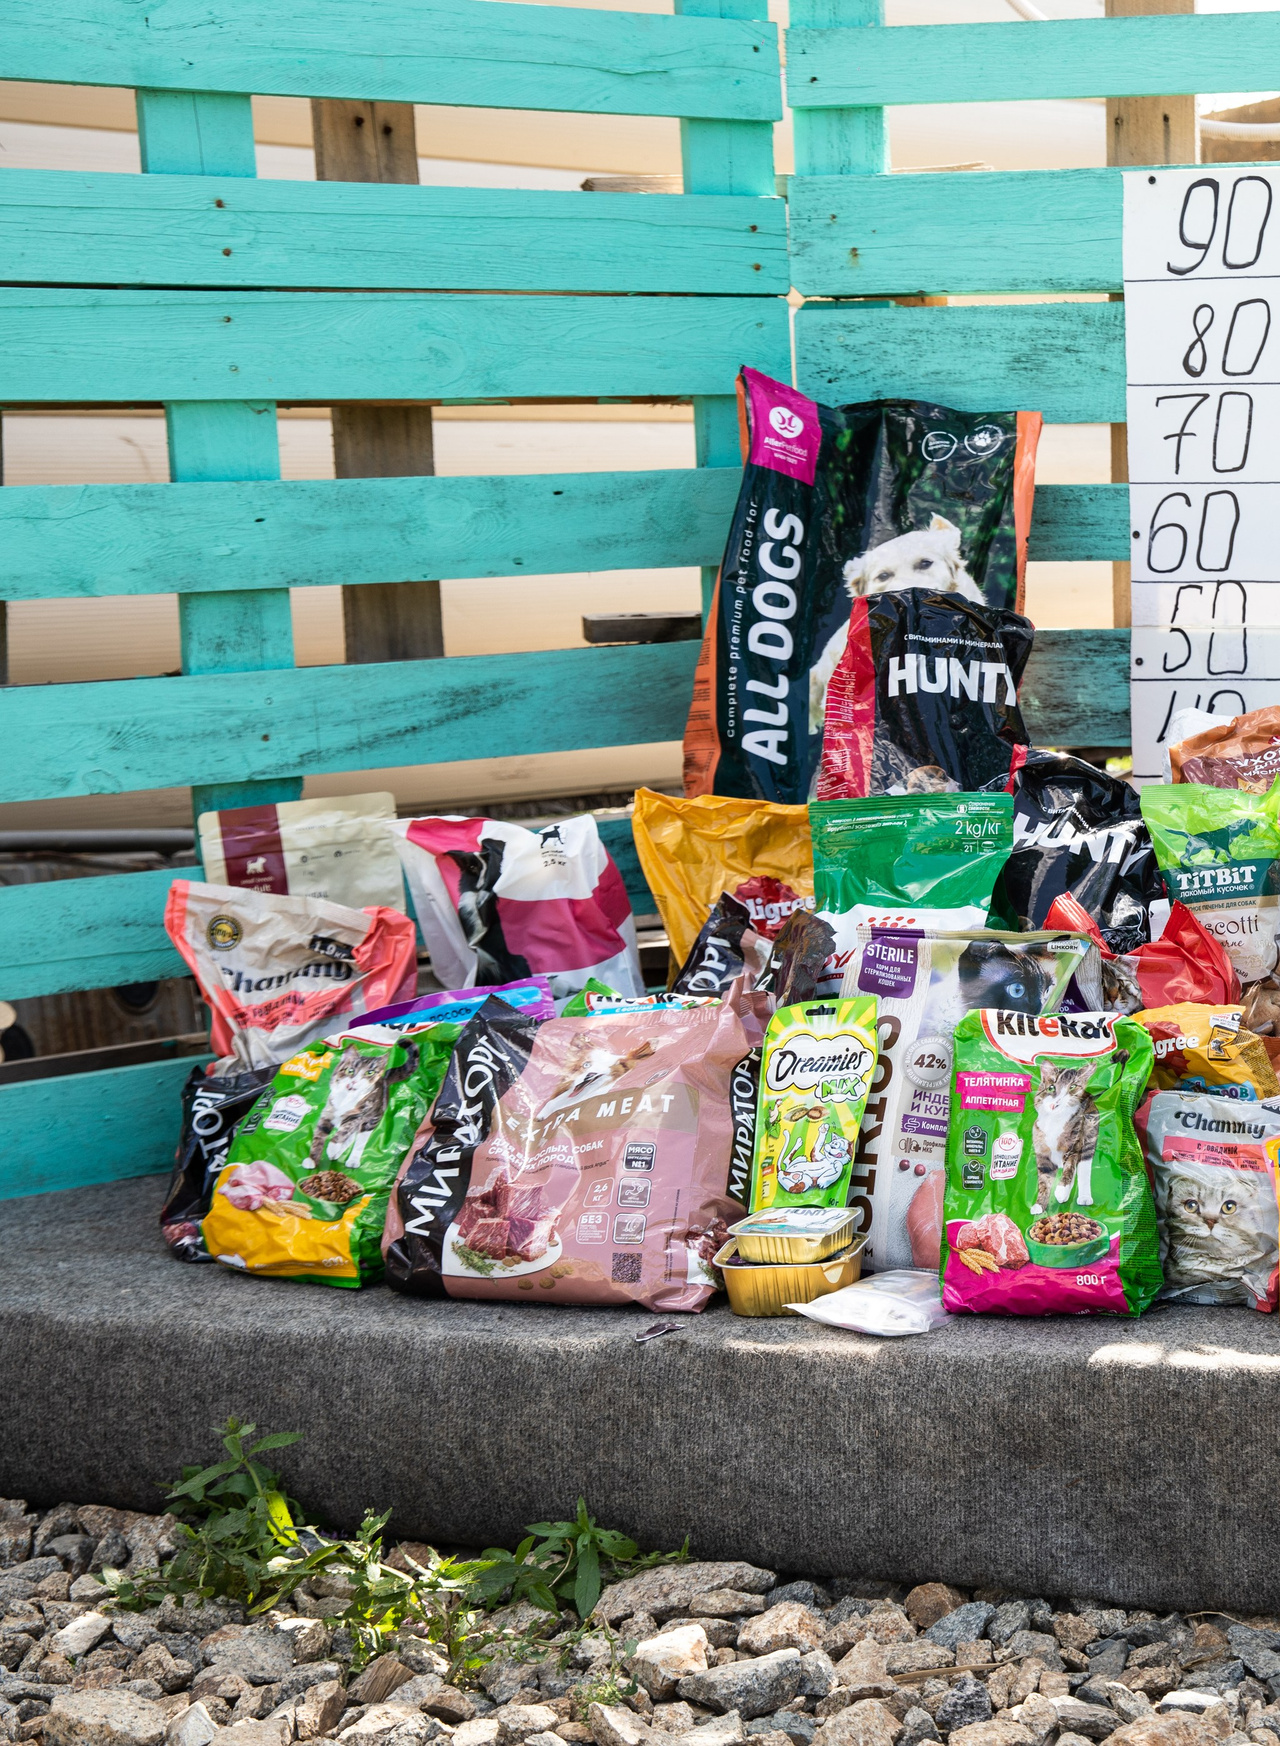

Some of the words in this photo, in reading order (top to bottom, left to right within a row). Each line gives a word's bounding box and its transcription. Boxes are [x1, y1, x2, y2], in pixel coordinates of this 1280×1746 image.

[1166, 176, 1273, 276] 90
[1182, 296, 1272, 379] 80
[1154, 391, 1254, 475] 70
[1146, 489, 1241, 574] 60
[738, 529, 755, 563] food
[734, 567, 748, 595] pet
[746, 507, 805, 661] DOGS
[729, 599, 744, 660] premium
[1161, 580, 1249, 676] 50
[909, 634, 959, 645] ВИТАМИНАМИ
[726, 666, 738, 738] Complete
[741, 673, 789, 766] ALL
[1013, 811, 1151, 878] HUNTY
[1180, 886, 1215, 899] лакомый
[1216, 883, 1249, 895] кусочек
[866, 943, 915, 964] STERILE
[864, 967, 912, 983] СТЕРИЛИЗОВАННЫХ
[875, 963, 889, 971] КОРМ
[877, 979, 896, 987] КОШЕК
[776, 1047, 868, 1083] Dreamies
[913, 1053, 947, 1070] 42%
[821, 1077, 861, 1098] MIX
[963, 1076, 1025, 1089] ТЕЛЯТИНКА
[596, 1093, 675, 1118] MEAT
[912, 1089, 950, 1106] ИНДЕ
[964, 1095, 1020, 1108] АППЕТИТНАЯ
[910, 1101, 921, 1113] И
[924, 1104, 950, 1117] КУР
[729, 1047, 762, 1199] МИРАТОРГ
[921, 1121, 948, 1133] Компле
[572, 1139, 605, 1155] СОБАК
[628, 1146, 654, 1154] МЯСО
[538, 1154, 575, 1167] ПОРОД
[581, 1215, 603, 1224] БЕЗ
[1076, 1274, 1099, 1286] 800
